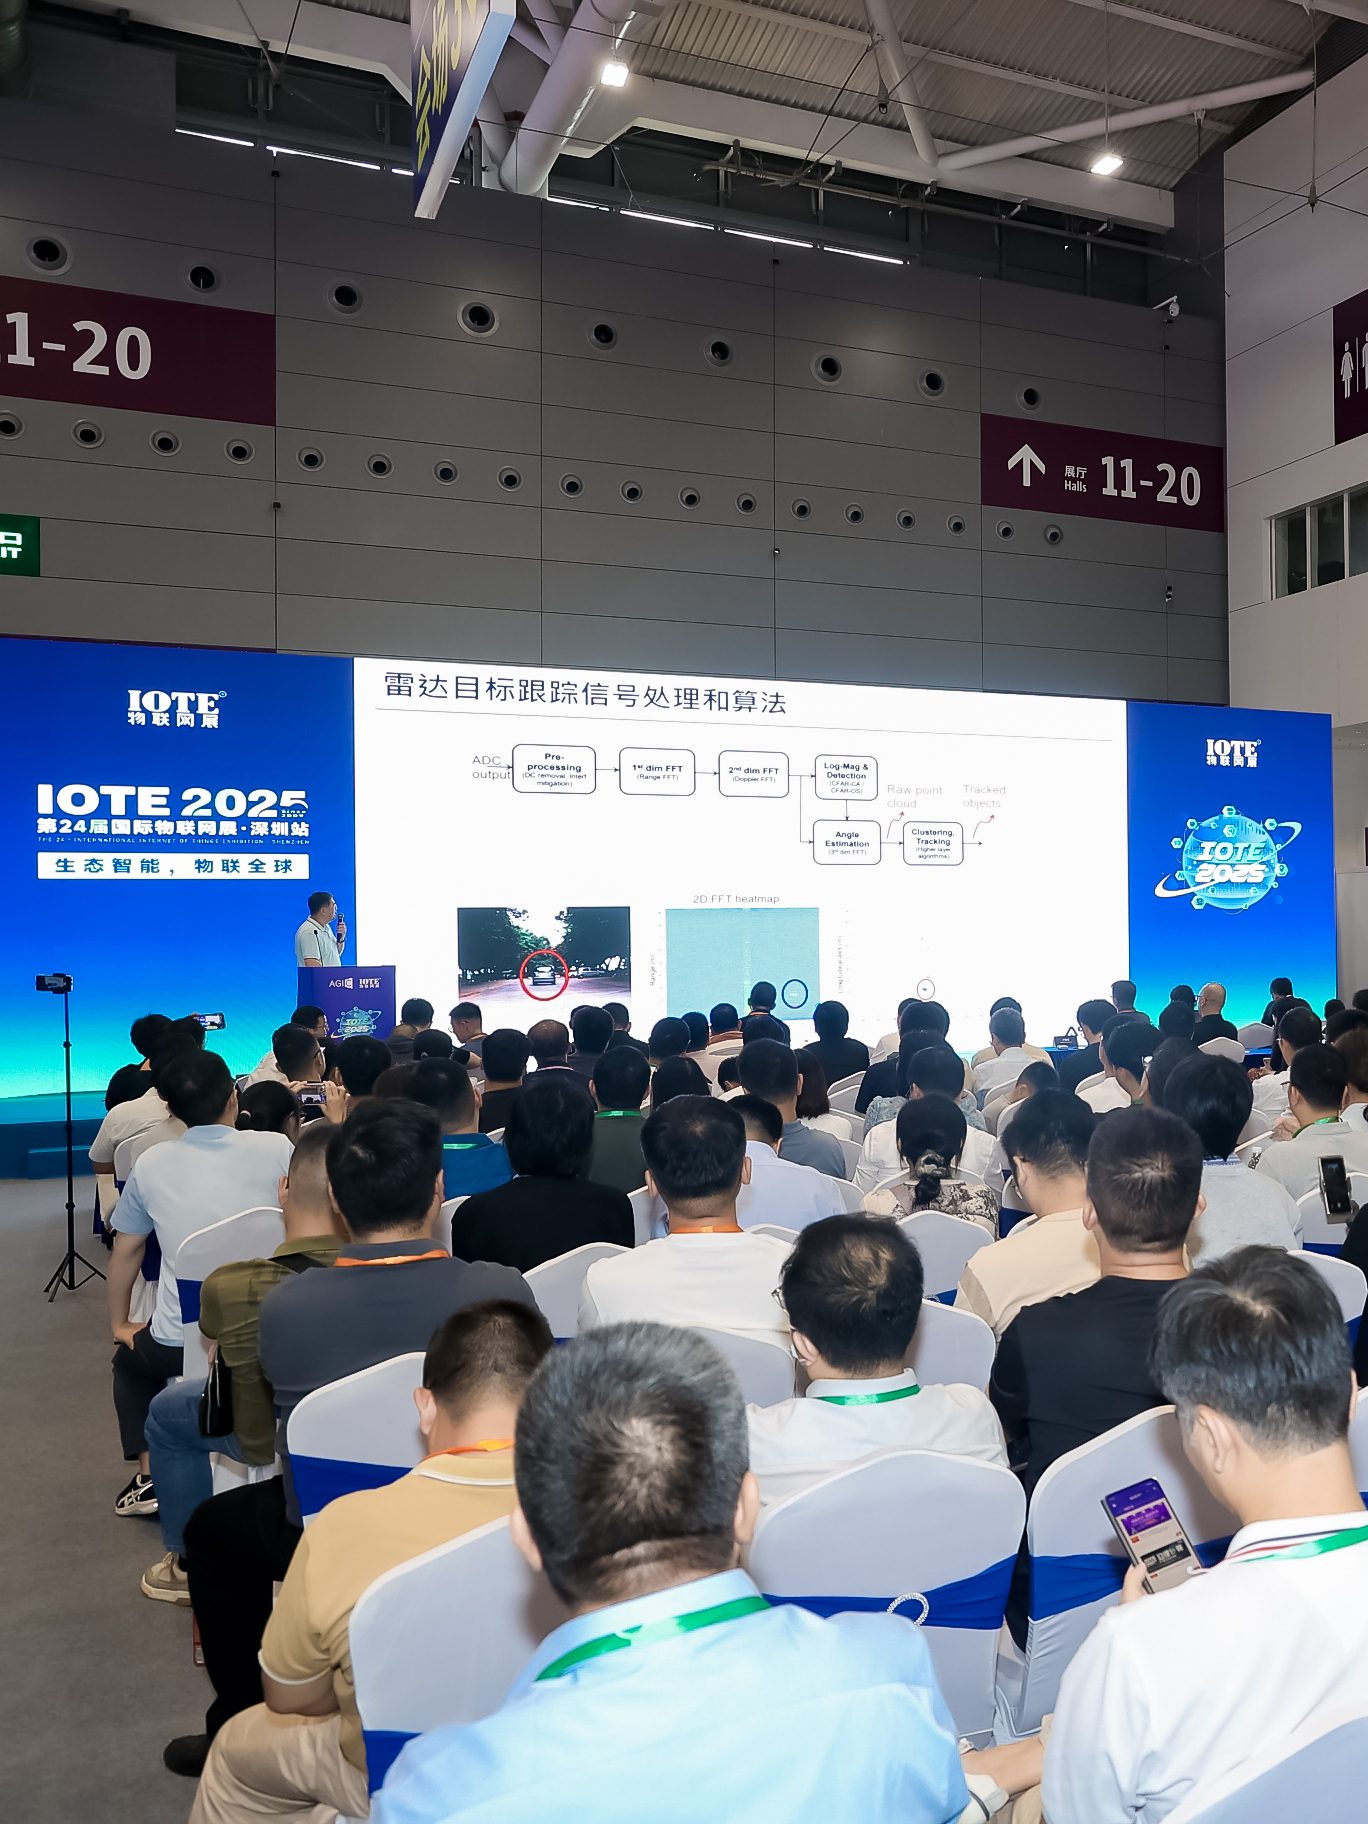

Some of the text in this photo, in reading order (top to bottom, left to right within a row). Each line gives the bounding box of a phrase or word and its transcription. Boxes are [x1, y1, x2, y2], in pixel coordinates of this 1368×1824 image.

[1064, 465, 1087, 479] 展厅
[1101, 456, 1200, 506] 11-20
[1064, 480, 1087, 493] Halls
[384, 671, 786, 714] 雷达目标跟踪信号处理和算法
[127, 711, 219, 729] 物联网展
[472, 755, 502, 766] ADC
[544, 752, 565, 761] Pre-
[527, 763, 582, 773] processing
[632, 764, 644, 772] 1st
[666, 765, 683, 773] FFT
[728, 766, 742, 774] 2nd
[763, 767, 780, 775] FFT
[824, 762, 869, 772] Log-Mag &
[472, 770, 511, 780] output
[663, 774, 679, 782] FFT)
[826, 772, 867, 780] Detection
[887, 784, 943, 796] Raw point
[963, 784, 1006, 795] Tracked
[38, 783, 309, 818] IOTE 2025
[886, 799, 917, 808] cloud
[962, 799, 1001, 809] objects
[37, 817, 310, 837] 第24届国际物联网展·深圳站
[835, 831, 860, 840] Angle
[911, 828, 955, 838] Clustering,
[825, 840, 870, 848] Estimation
[916, 838, 951, 847] Tracking
[1198, 842, 1267, 861] IOTE
[1195, 863, 1266, 883] 2025
[693, 894, 780, 905] 2D FFT heatmap
[344, 1018, 369, 1026] IOTE
